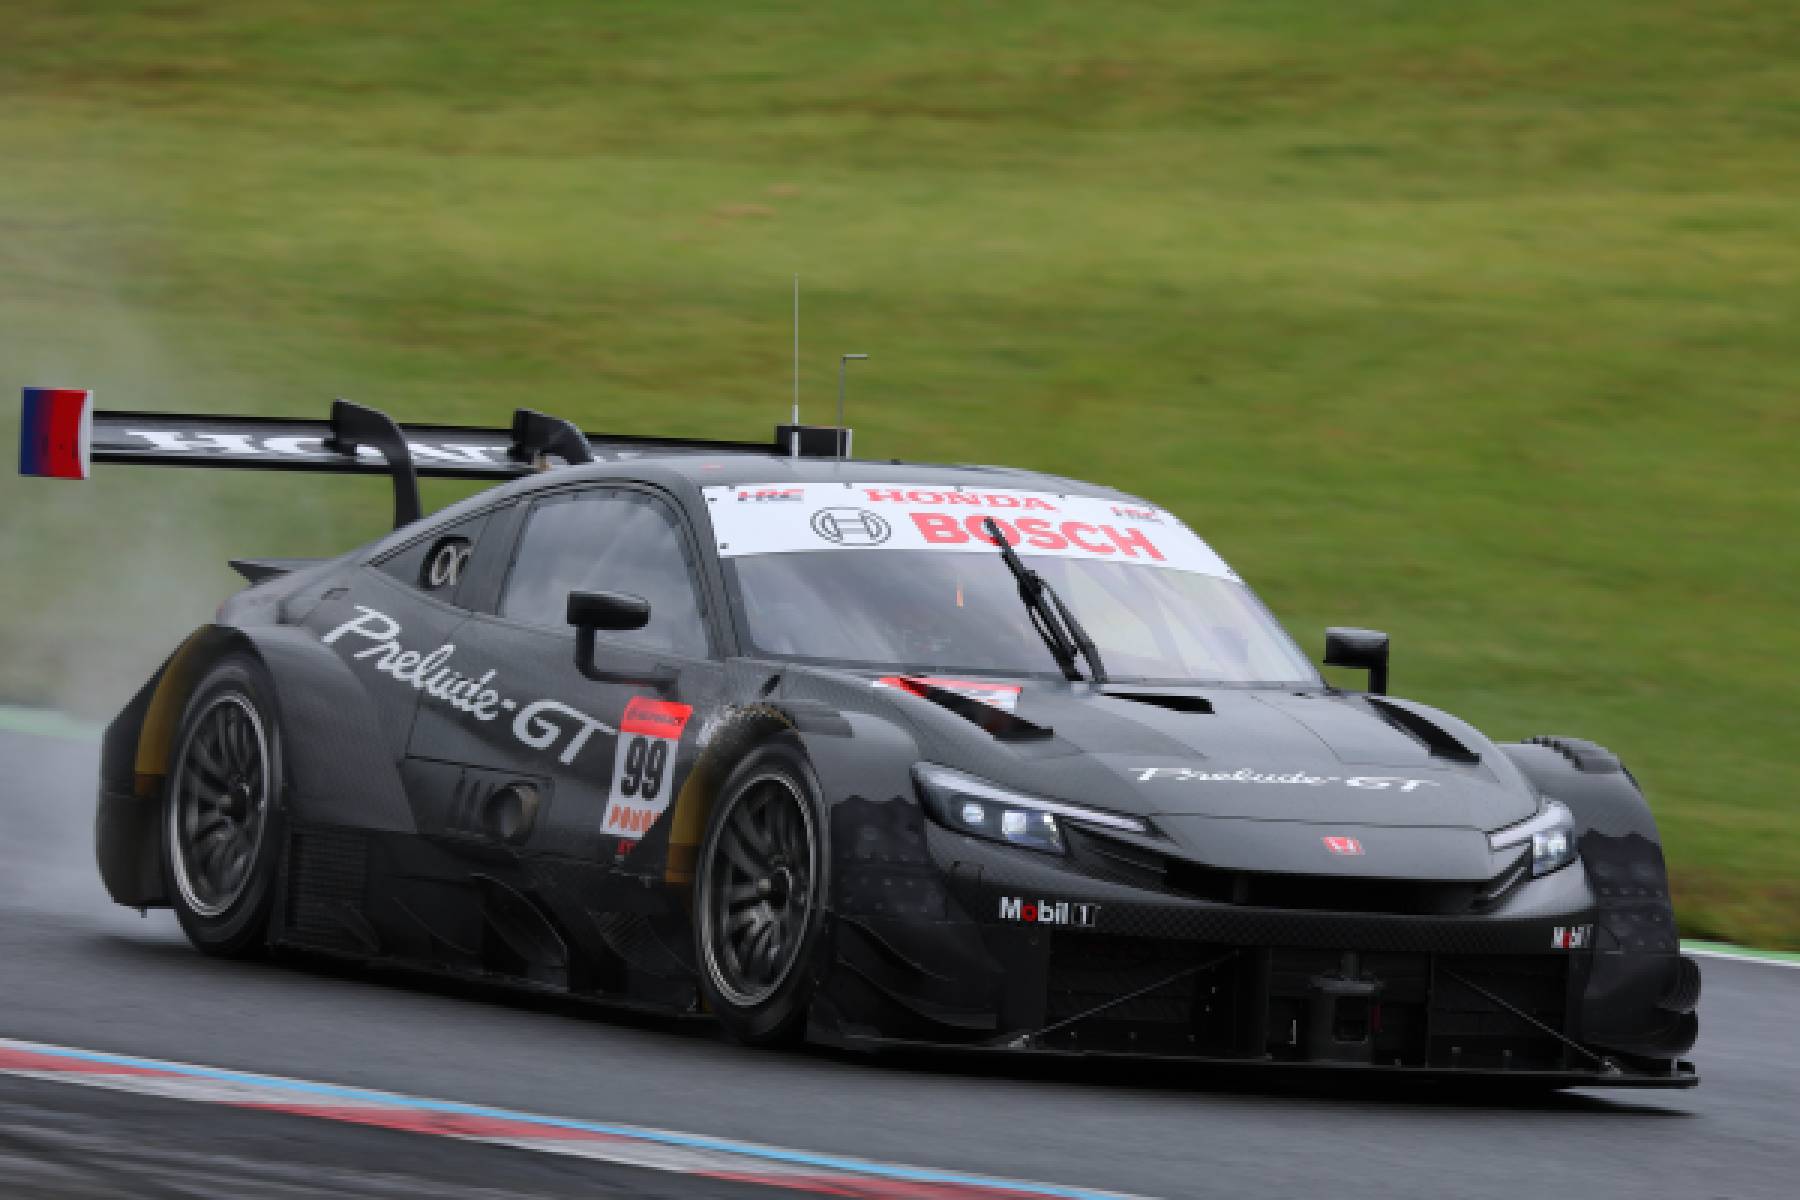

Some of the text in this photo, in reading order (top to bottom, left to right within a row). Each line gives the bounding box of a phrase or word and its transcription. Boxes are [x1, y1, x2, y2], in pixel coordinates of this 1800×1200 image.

[863, 489, 1058, 511] HONDA
[909, 512, 1168, 561] BOSCH
[620, 735, 668, 800] 99
[999, 896, 1069, 925] Mobil
